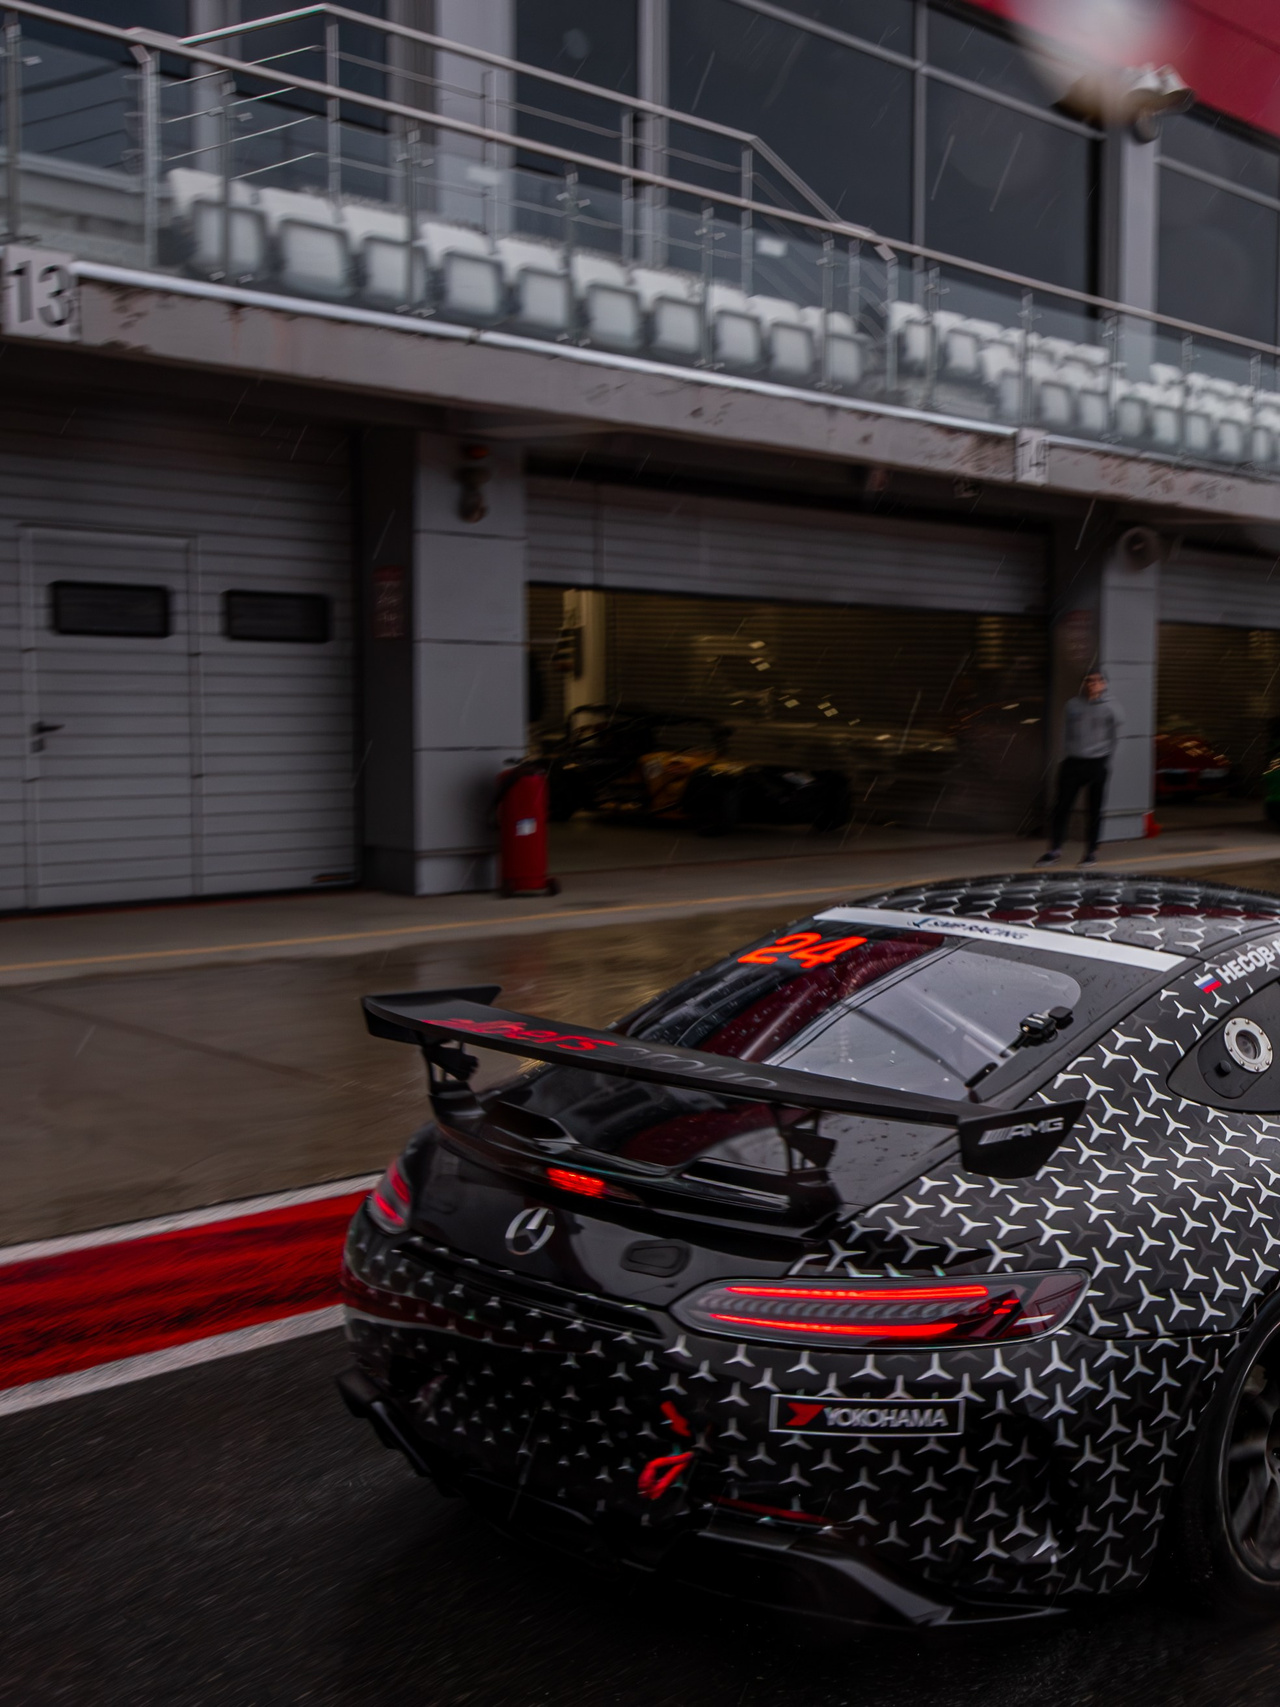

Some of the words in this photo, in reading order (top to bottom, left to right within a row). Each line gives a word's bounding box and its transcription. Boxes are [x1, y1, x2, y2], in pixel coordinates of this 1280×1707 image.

[6, 258, 77, 328] 13
[737, 932, 868, 969] 24
[1215, 945, 1276, 984] НЕСОВ
[1006, 1116, 1065, 1139] AMG
[822, 1407, 949, 1428] YOKOHAMA
